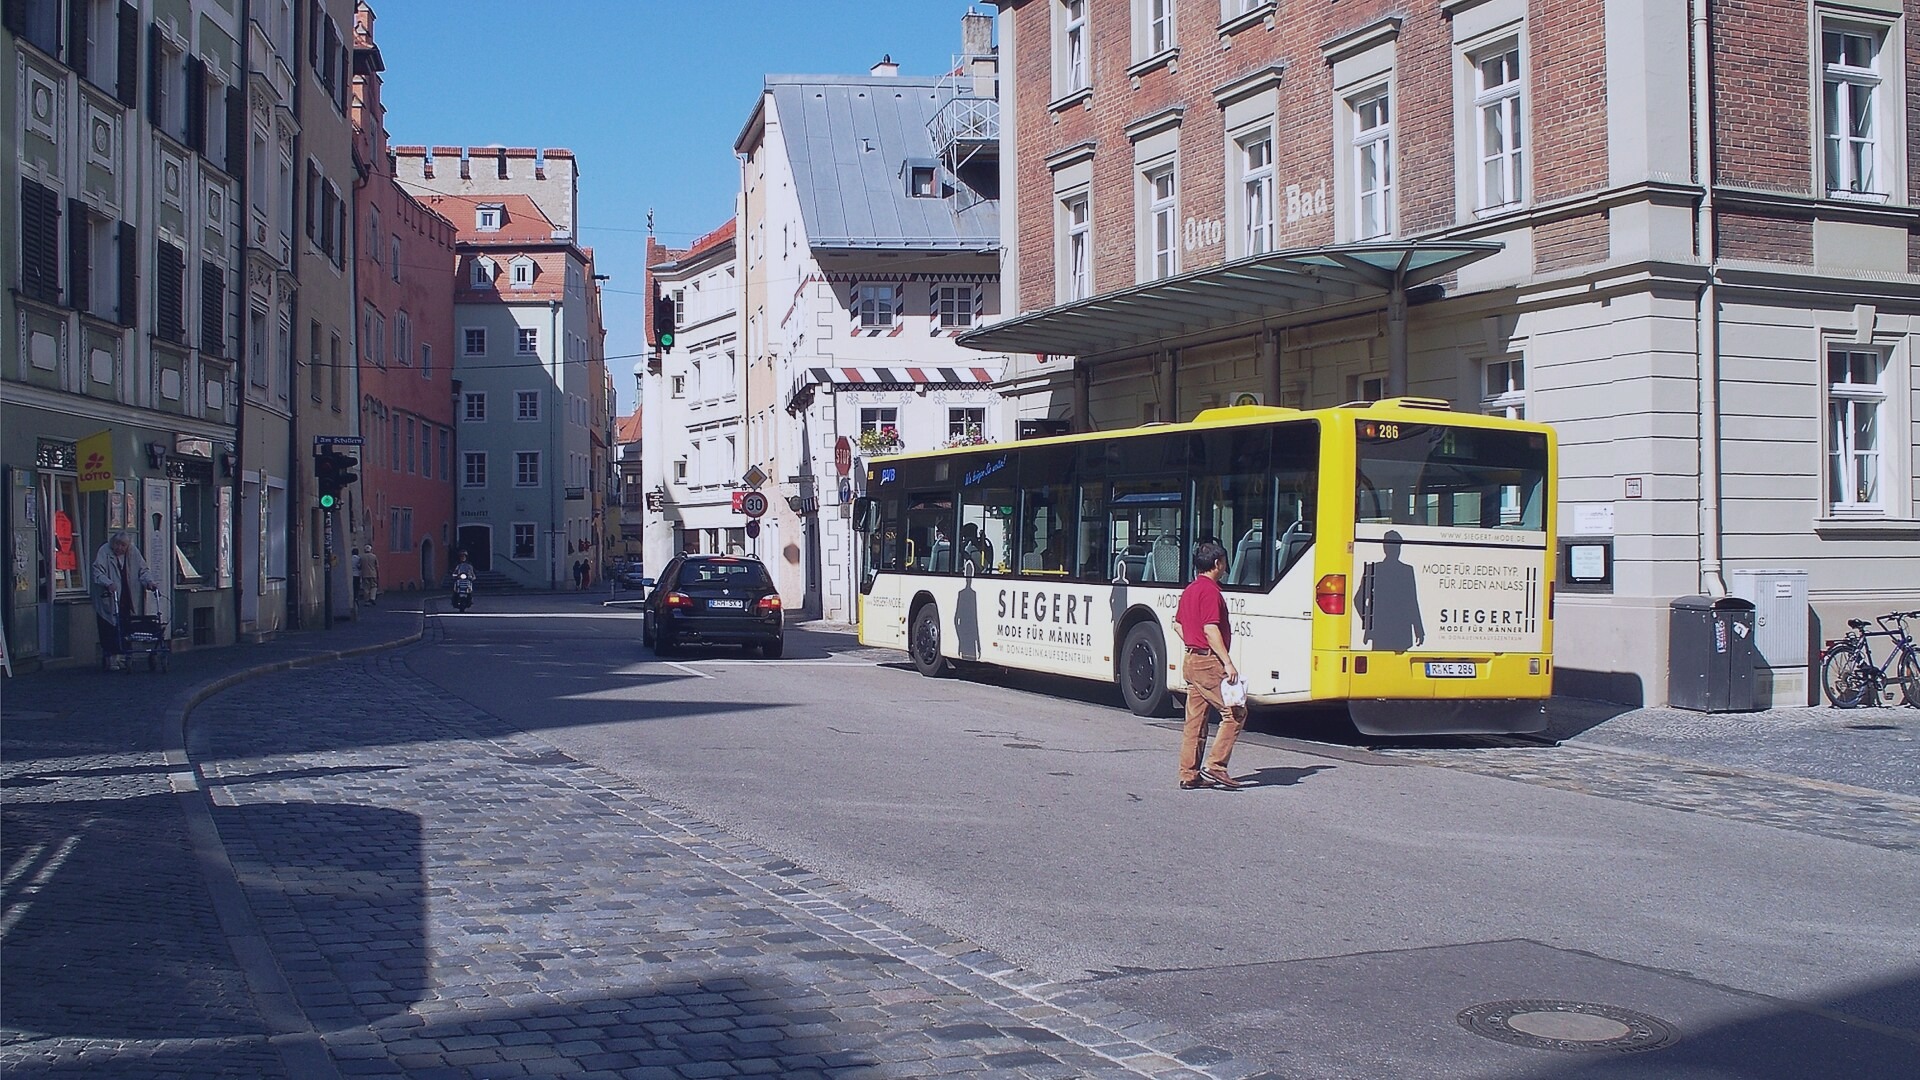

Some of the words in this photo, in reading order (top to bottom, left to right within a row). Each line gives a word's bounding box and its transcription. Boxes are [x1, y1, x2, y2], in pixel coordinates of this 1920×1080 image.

[1184, 217, 1222, 251] Otto
[1285, 178, 1328, 223] Bad
[1379, 424, 1399, 439] 286
[835, 449, 850, 465] STOP
[80, 471, 111, 481] LOTTO
[747, 498, 762, 511] 30
[1422, 563, 1451, 575] MODE
[1453, 562, 1470, 575] FÜR
[1472, 565, 1501, 576] JEDEN
[1503, 566, 1519, 577] TYP.
[1439, 576, 1456, 589] FÜR
[1458, 579, 1487, 590] JEDEN
[1488, 580, 1525, 591] ANLASS.
[998, 589, 1093, 626] SIEGERT
[1157, 594, 1182, 609] MOD
[1229, 598, 1247, 614] TYP.
[1440, 609, 1523, 624] SIEGERT
[997, 624, 1022, 638] MODE
[1026, 624, 1044, 641] FÜR
[1048, 626, 1092, 647] MÄNNER
[1468, 624, 1483, 633] FÜR
[1488, 624, 1522, 633] MÄNNER
[1431, 664, 1438, 674] R
[1442, 664, 1454, 674] KE
[1457, 664, 1473, 675] 286
